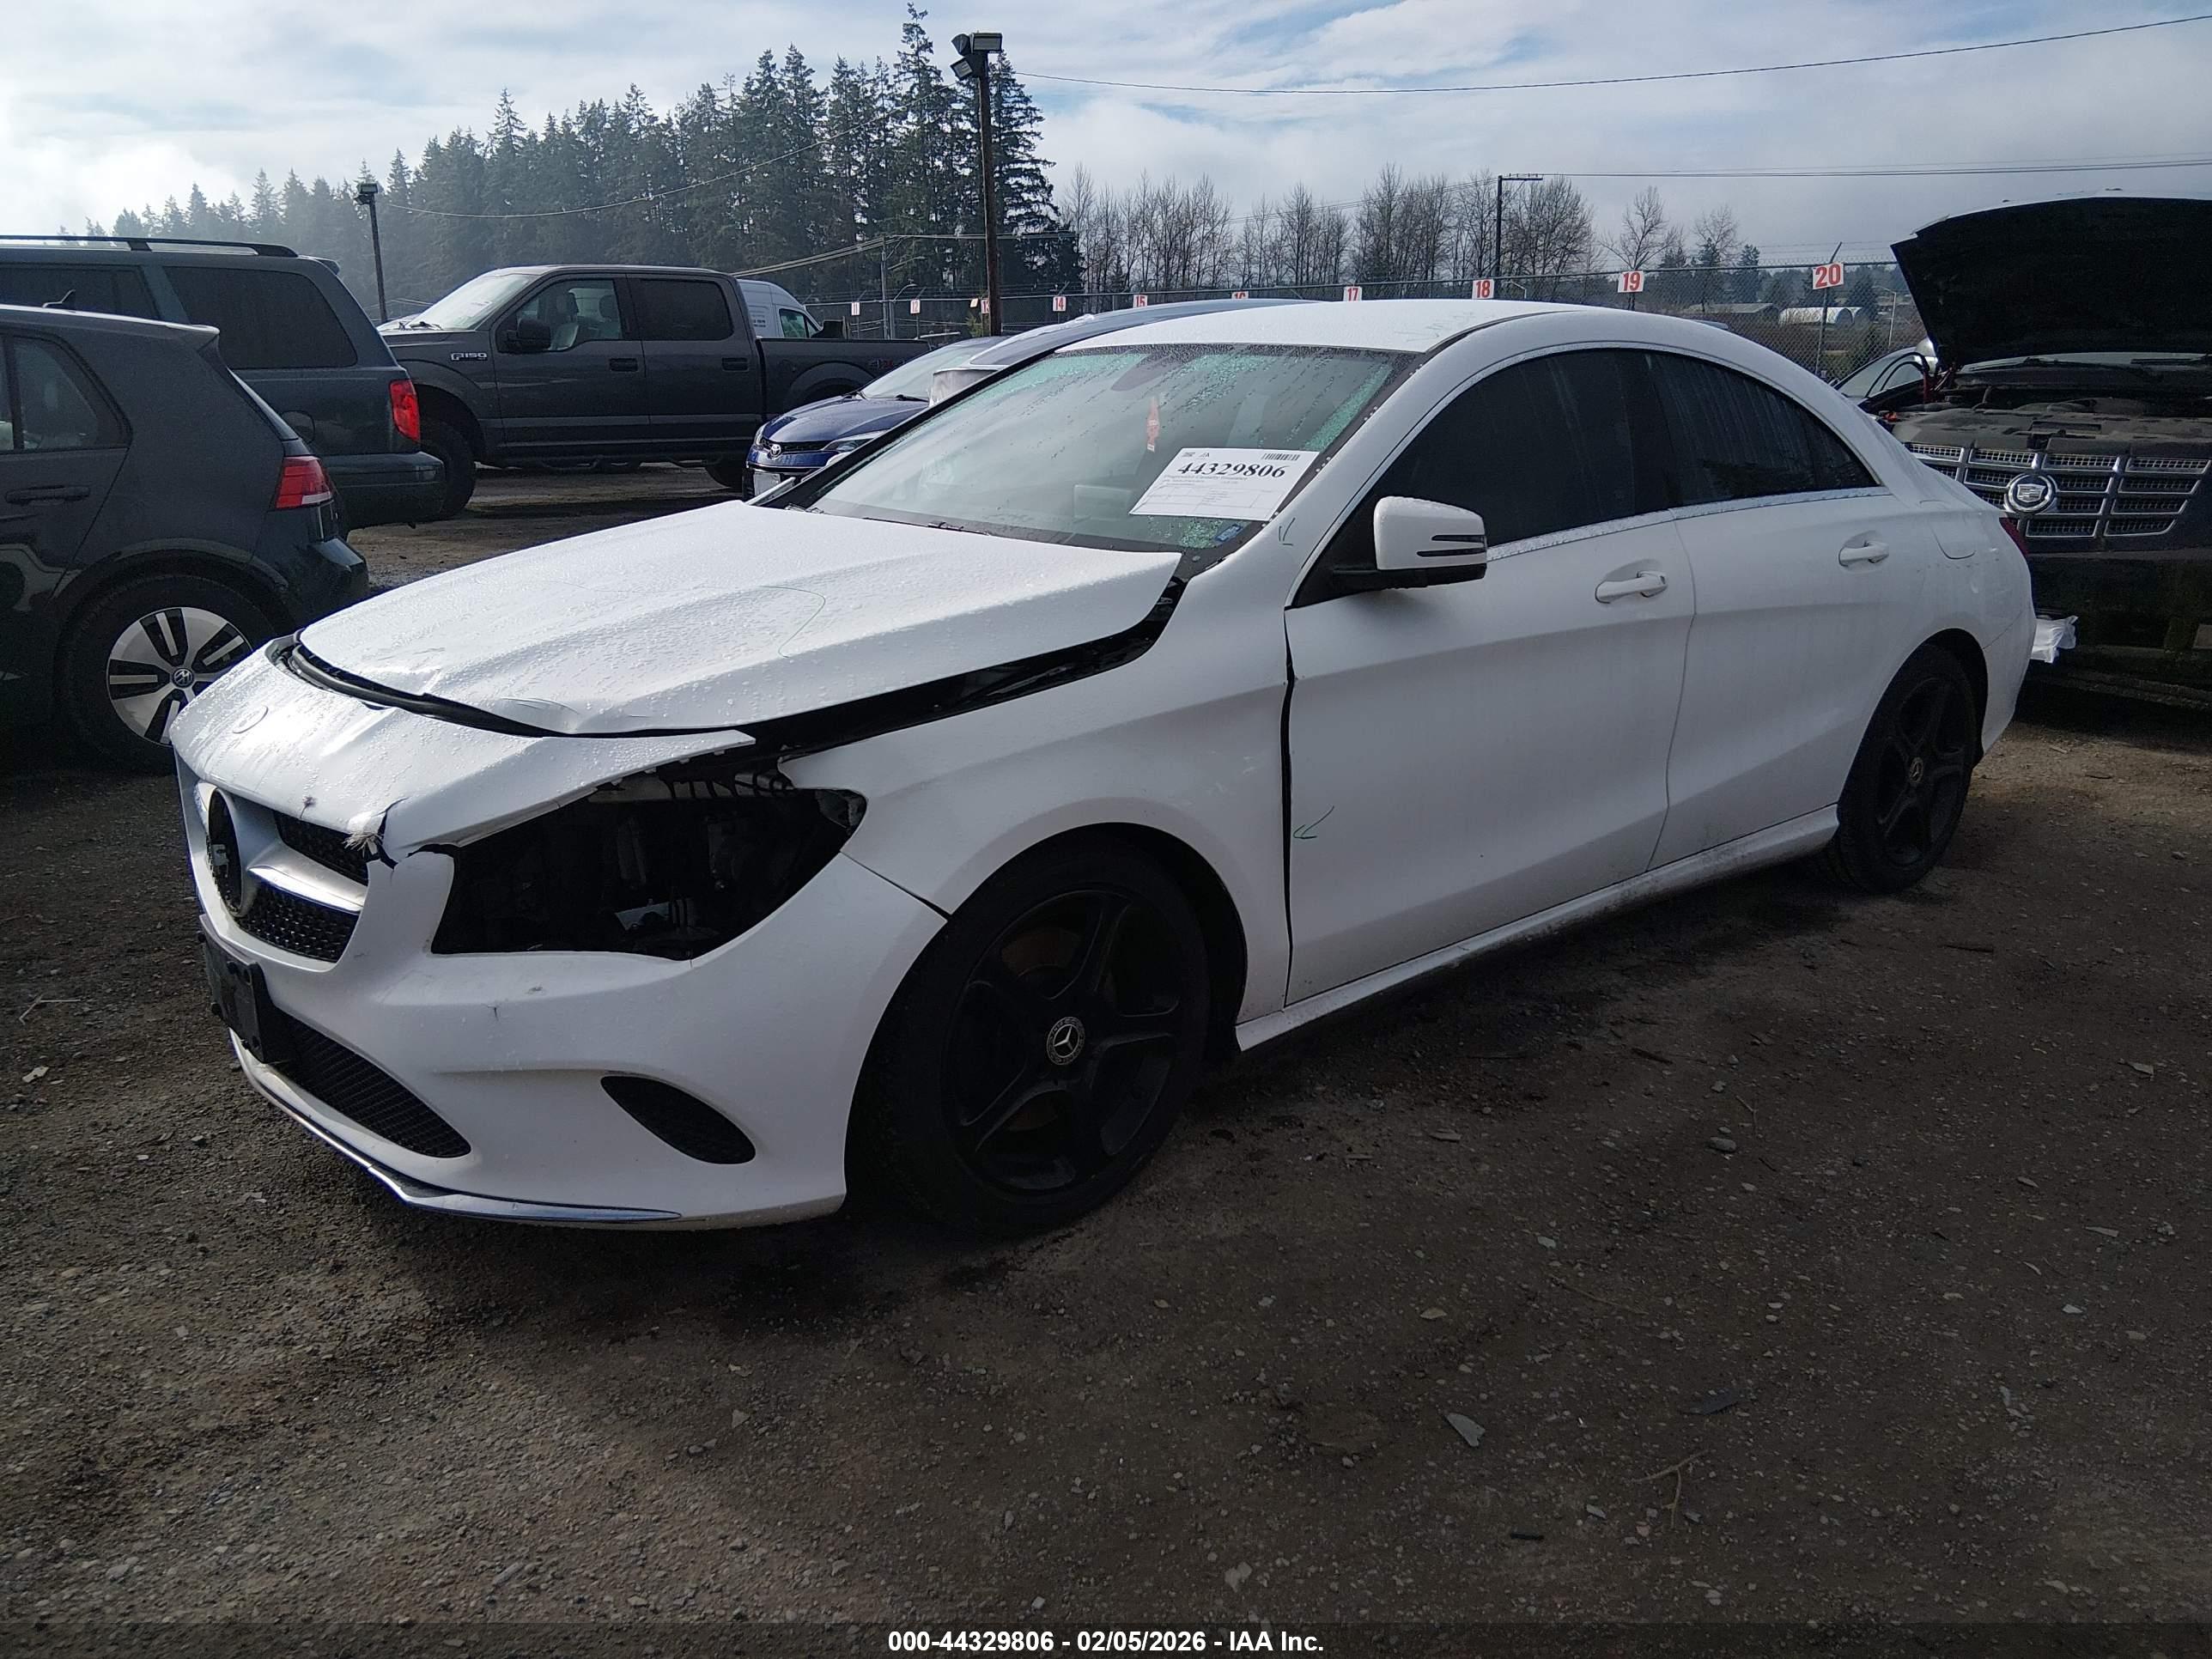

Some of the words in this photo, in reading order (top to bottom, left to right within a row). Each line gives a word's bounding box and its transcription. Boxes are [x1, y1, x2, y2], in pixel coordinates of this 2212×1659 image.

[1622, 271, 1642, 292] 19
[1814, 263, 1842, 289] 20
[1346, 287, 1359, 301] 17
[1474, 280, 1492, 299] 18
[911, 301, 920, 313] 12
[1054, 296, 1065, 311] 14
[1135, 295, 1146, 308] 15
[1176, 462, 1291, 478] 44329806
